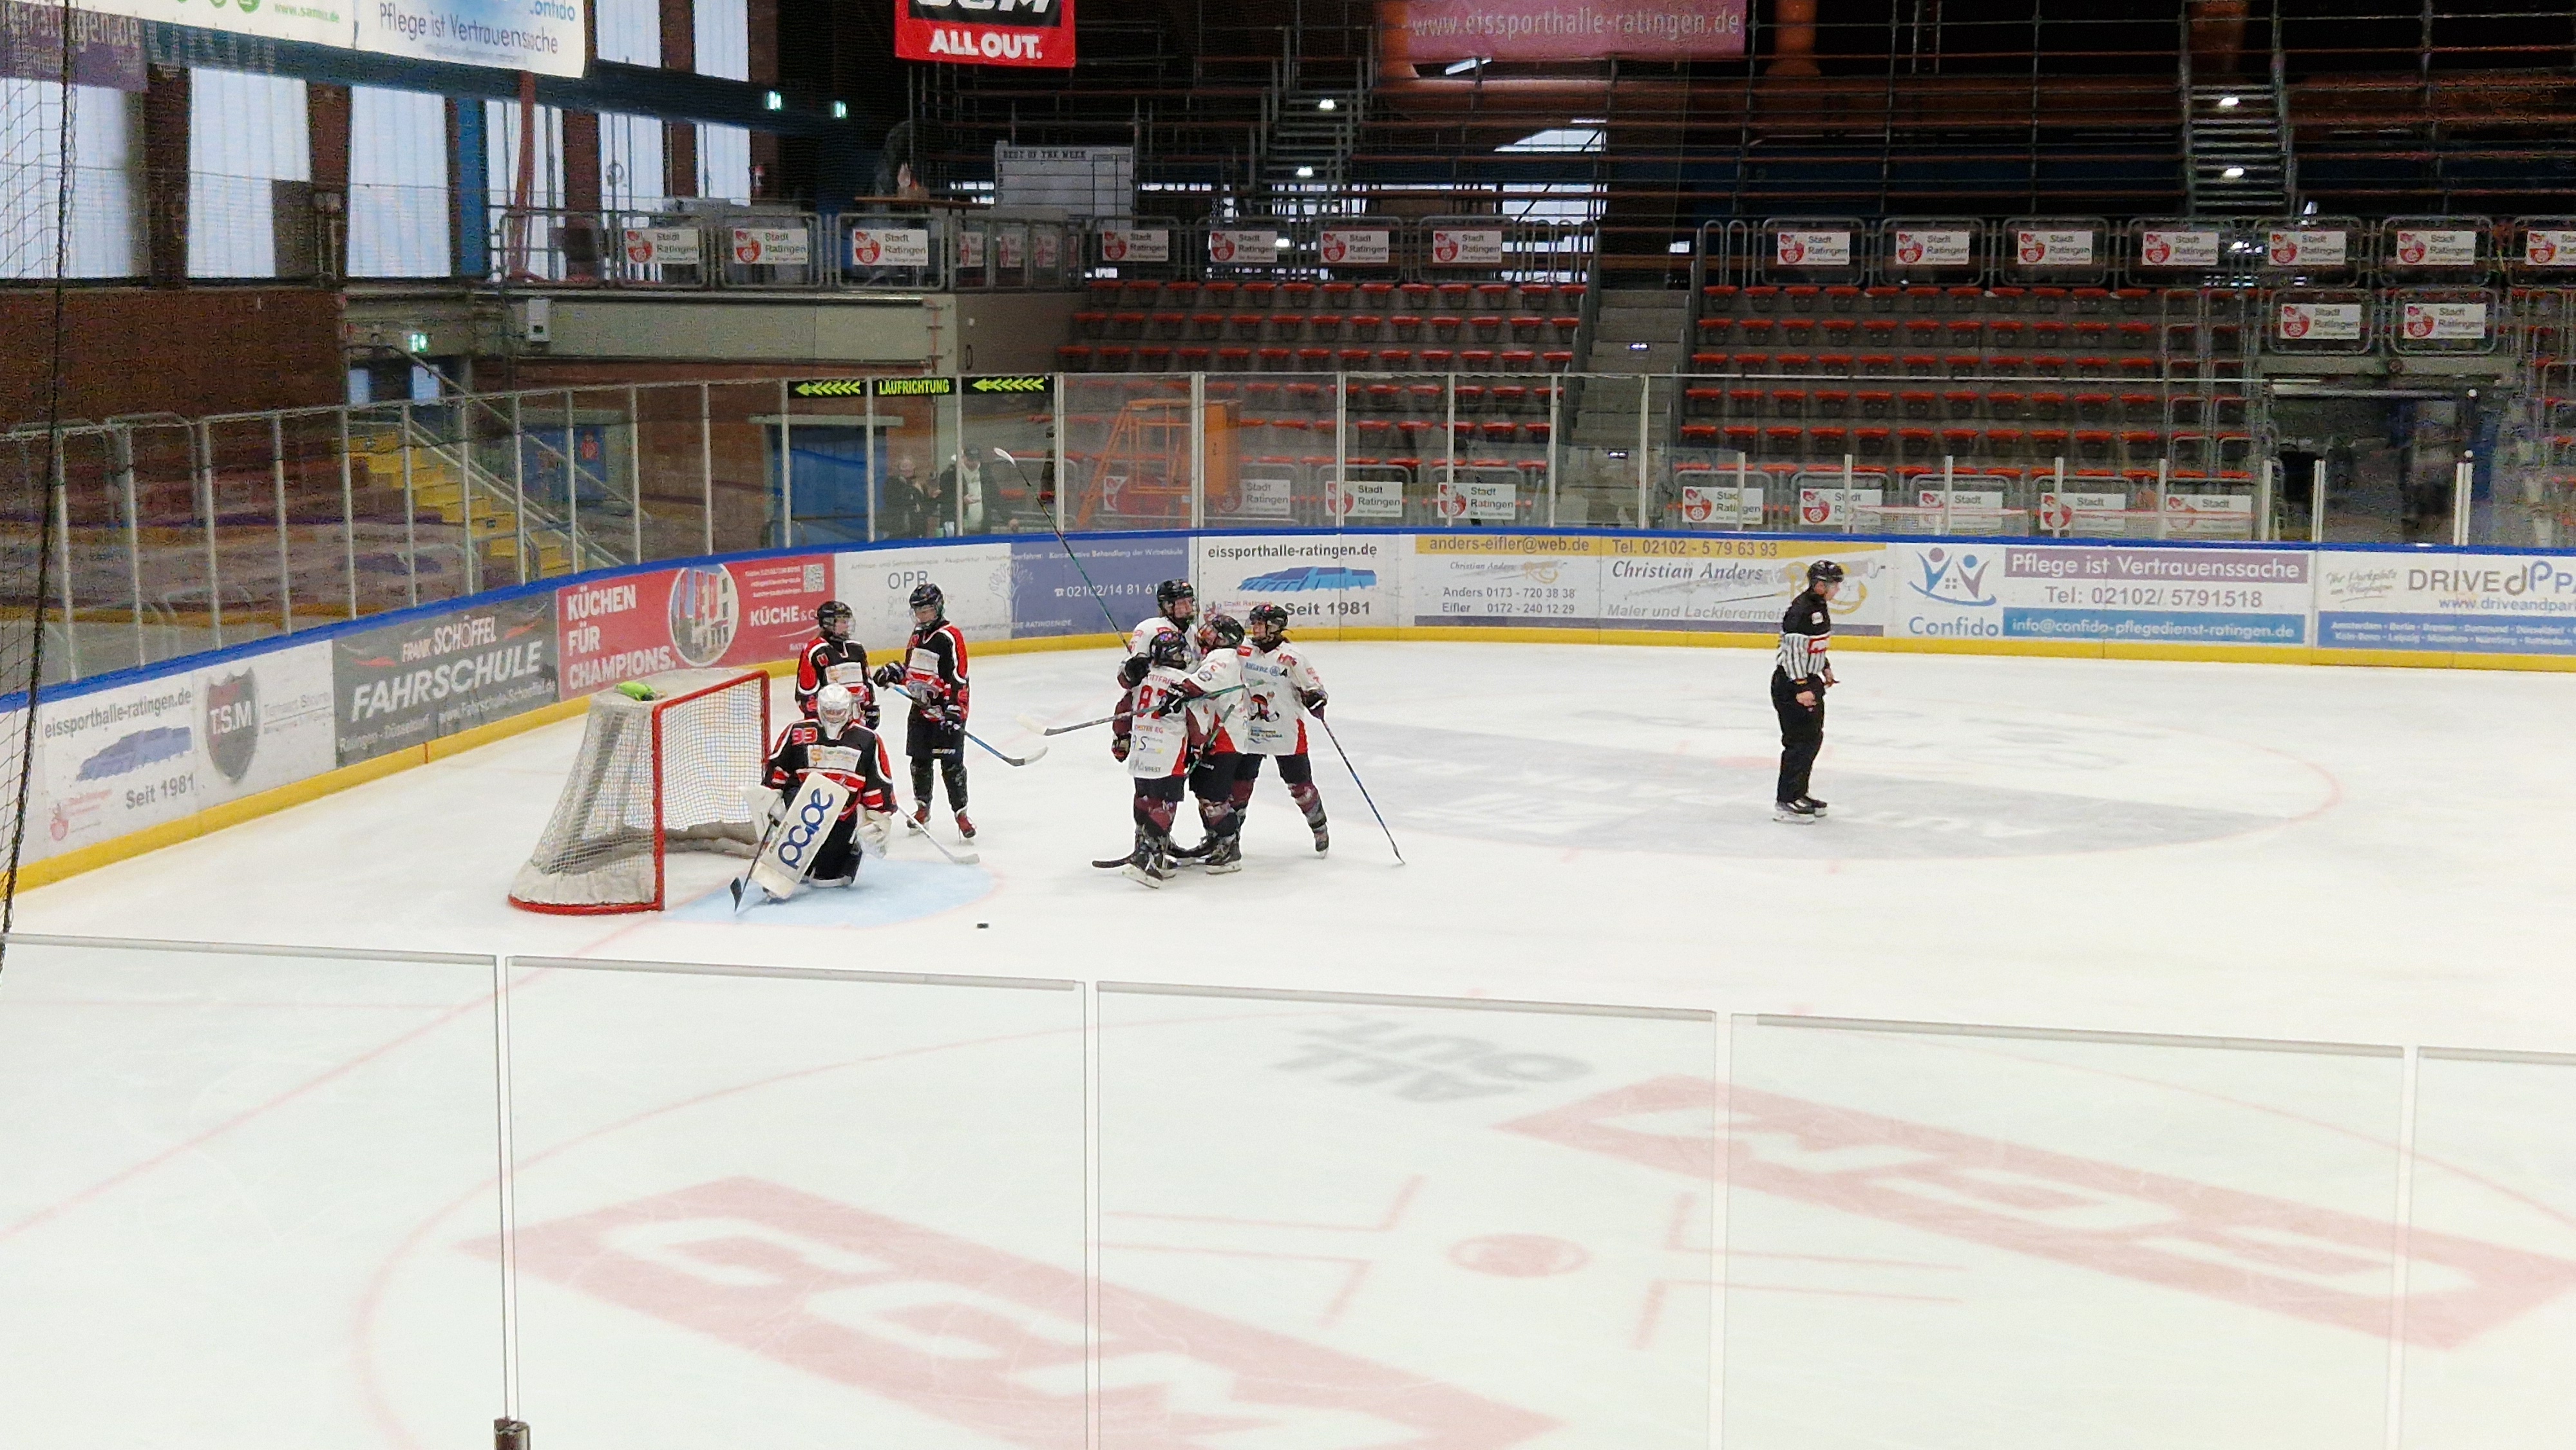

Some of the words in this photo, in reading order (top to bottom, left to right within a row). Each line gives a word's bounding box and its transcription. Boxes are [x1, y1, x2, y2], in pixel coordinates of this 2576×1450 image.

[529, 0, 576, 21] onfido
[379, 3, 426, 42] Pflege
[431, 11, 446, 39] ist
[1411, 8, 1739, 39] www.eissporthalle-ratingen.de
[929, 29, 979, 56] ALL
[981, 32, 1043, 59] OUT.
[878, 379, 950, 395] LAUFRICHTUNG
[1358, 485, 1383, 494] Stadt
[1470, 487, 1496, 496] Stadt
[1834, 493, 1861, 501] Stdt
[1247, 494, 1289, 504] Ratingen
[1358, 497, 1400, 507] Ratingen
[1470, 499, 1513, 510] Ratingen
[1954, 496, 1982, 504] Stadt
[1716, 504, 1761, 514] Ratigen
[1208, 543, 1378, 560] eissporthalle-ratingen.de
[1430, 536, 1589, 554] anders-eifler@web.de
[1613, 541, 1636, 554] Tel.
[1642, 540, 1686, 555] 02102
[1702, 541, 1710, 554] 5
[1716, 541, 1732, 556] 79
[1738, 542, 1754, 556] 63
[1760, 542, 1777, 556] 93
[1612, 560, 1693, 579] Christian
[1700, 561, 1763, 581] Anders
[2012, 554, 2078, 574] Pflege
[2085, 555, 2110, 572] ist
[2117, 556, 2300, 578] Vertrauenssache
[1127, 583, 1140, 596] 81
[1443, 587, 1482, 598] Anders
[1486, 588, 1512, 598] 0173
[1524, 588, 1542, 598] 720
[1546, 588, 1558, 599] 38
[1562, 589, 1575, 599] 38
[2045, 585, 2083, 603] Tel:
[2091, 587, 2163, 605] 02102/
[2172, 590, 2263, 608] 5791518
[567, 584, 636, 621] KÜCHEN
[1285, 602, 1320, 616] Seit
[1327, 601, 1370, 615] 1981
[1442, 602, 1471, 612] Eifler
[1487, 603, 1512, 612] 0172
[1524, 603, 1542, 613] 240
[1547, 603, 1558, 613] 12
[1562, 604, 1575, 614] 29
[2439, 596, 2576, 611] www.driveandpar
[750, 605, 799, 627] KÜCHE
[800, 610, 807, 621] &
[1607, 604, 1647, 617] Maler
[1653, 605, 1680, 618] und
[1684, 605, 1785, 620] Lackierermeis
[433, 615, 497, 655] SCHÖFFEL
[1909, 616, 1999, 637] Confido
[2012, 618, 2295, 639] info@confido-pflegedienst-ratingen.de
[568, 626, 600, 656] FÜR
[569, 645, 676, 691] CHAMPIONS.
[352, 639, 544, 722] FAHRSCHULE
[44, 687, 192, 739] eissporthalle-ratingen.de
[125, 784, 156, 810] Seit
[160, 773, 195, 801] 1981
